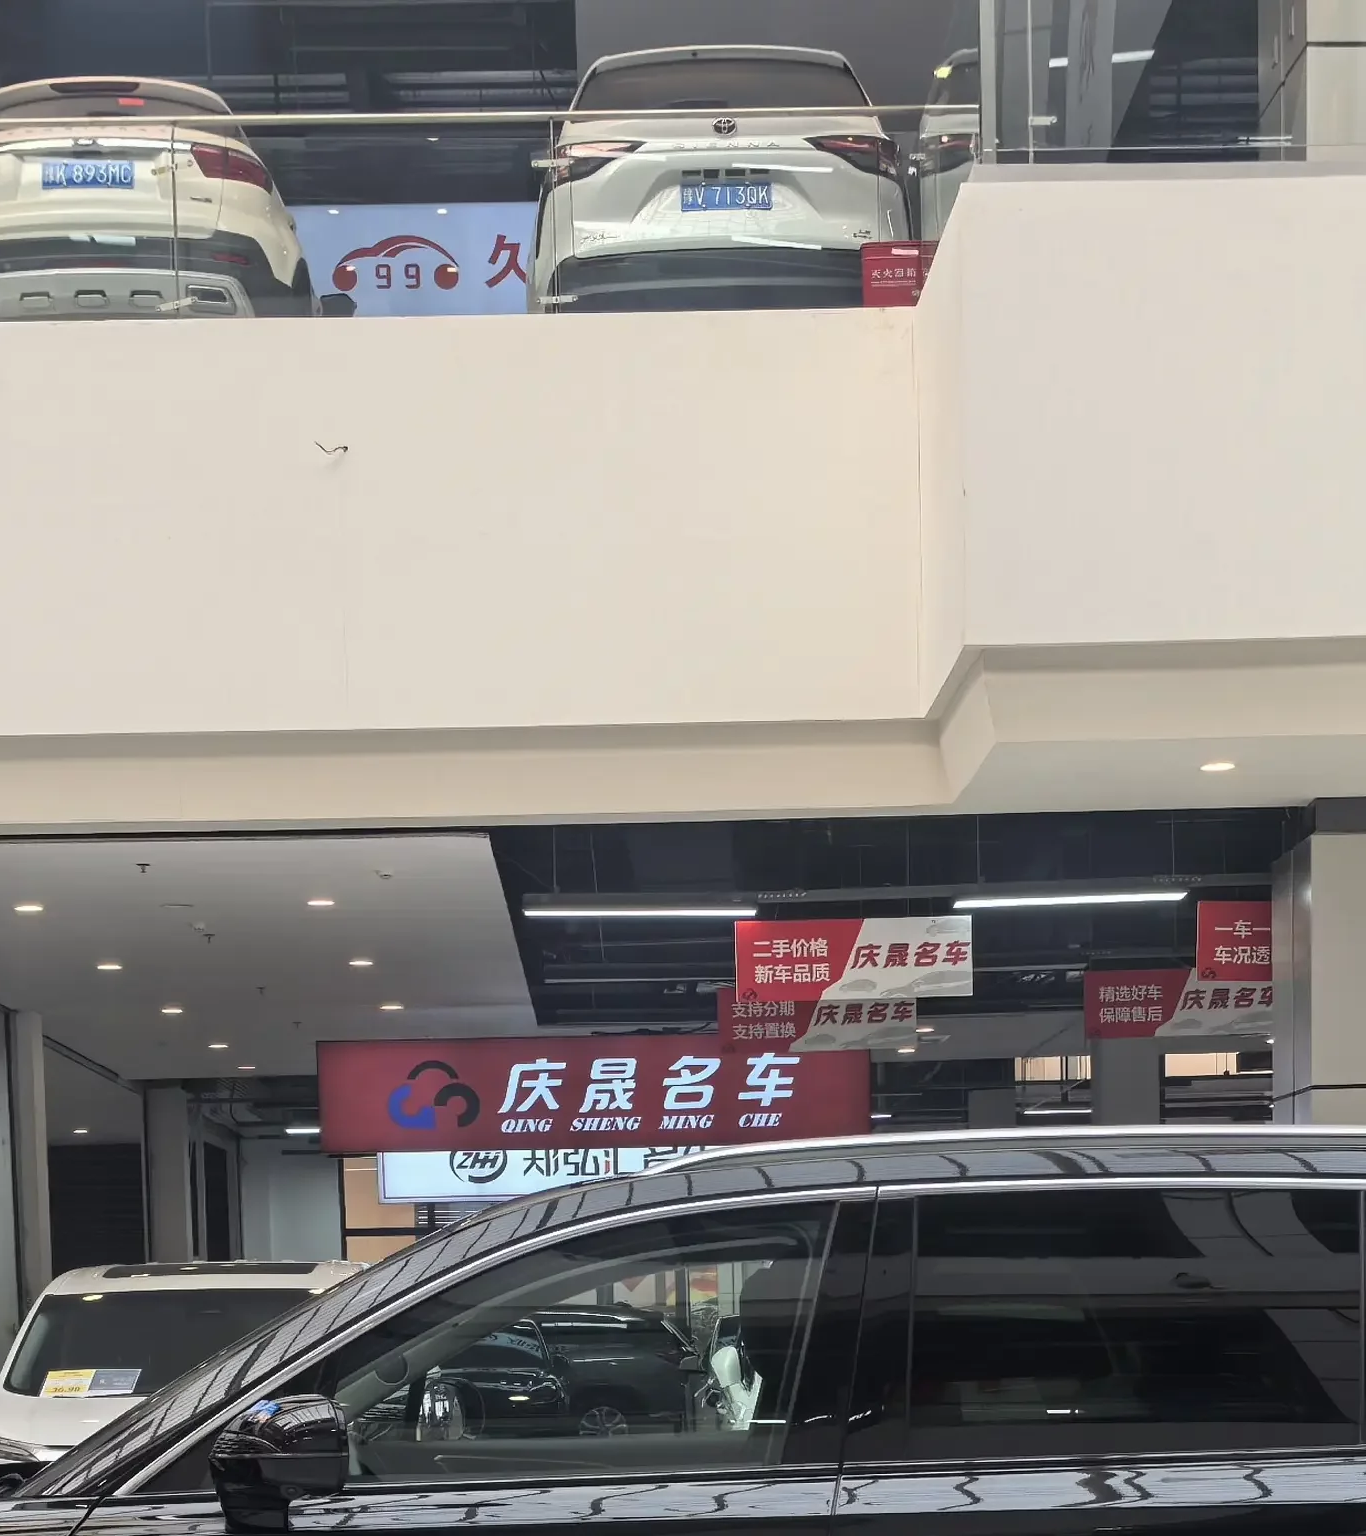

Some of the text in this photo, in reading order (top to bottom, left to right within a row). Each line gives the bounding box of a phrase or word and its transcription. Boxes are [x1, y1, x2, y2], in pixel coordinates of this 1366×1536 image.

[484, 234, 527, 288] 久
[753, 938, 829, 959] 二手价格
[850, 940, 972, 970] 庆晟名车
[754, 963, 831, 984] 新车品质
[1098, 984, 1163, 1003] 精选好车
[731, 1000, 796, 1018] 支持分期
[813, 1001, 915, 1026] 庆晟名车
[1098, 1006, 1163, 1024] 保障售后
[732, 1022, 797, 1040] 支持置换
[497, 1052, 800, 1114] 庆晟名车
[500, 1112, 783, 1133] QING SHENG MING CHE
